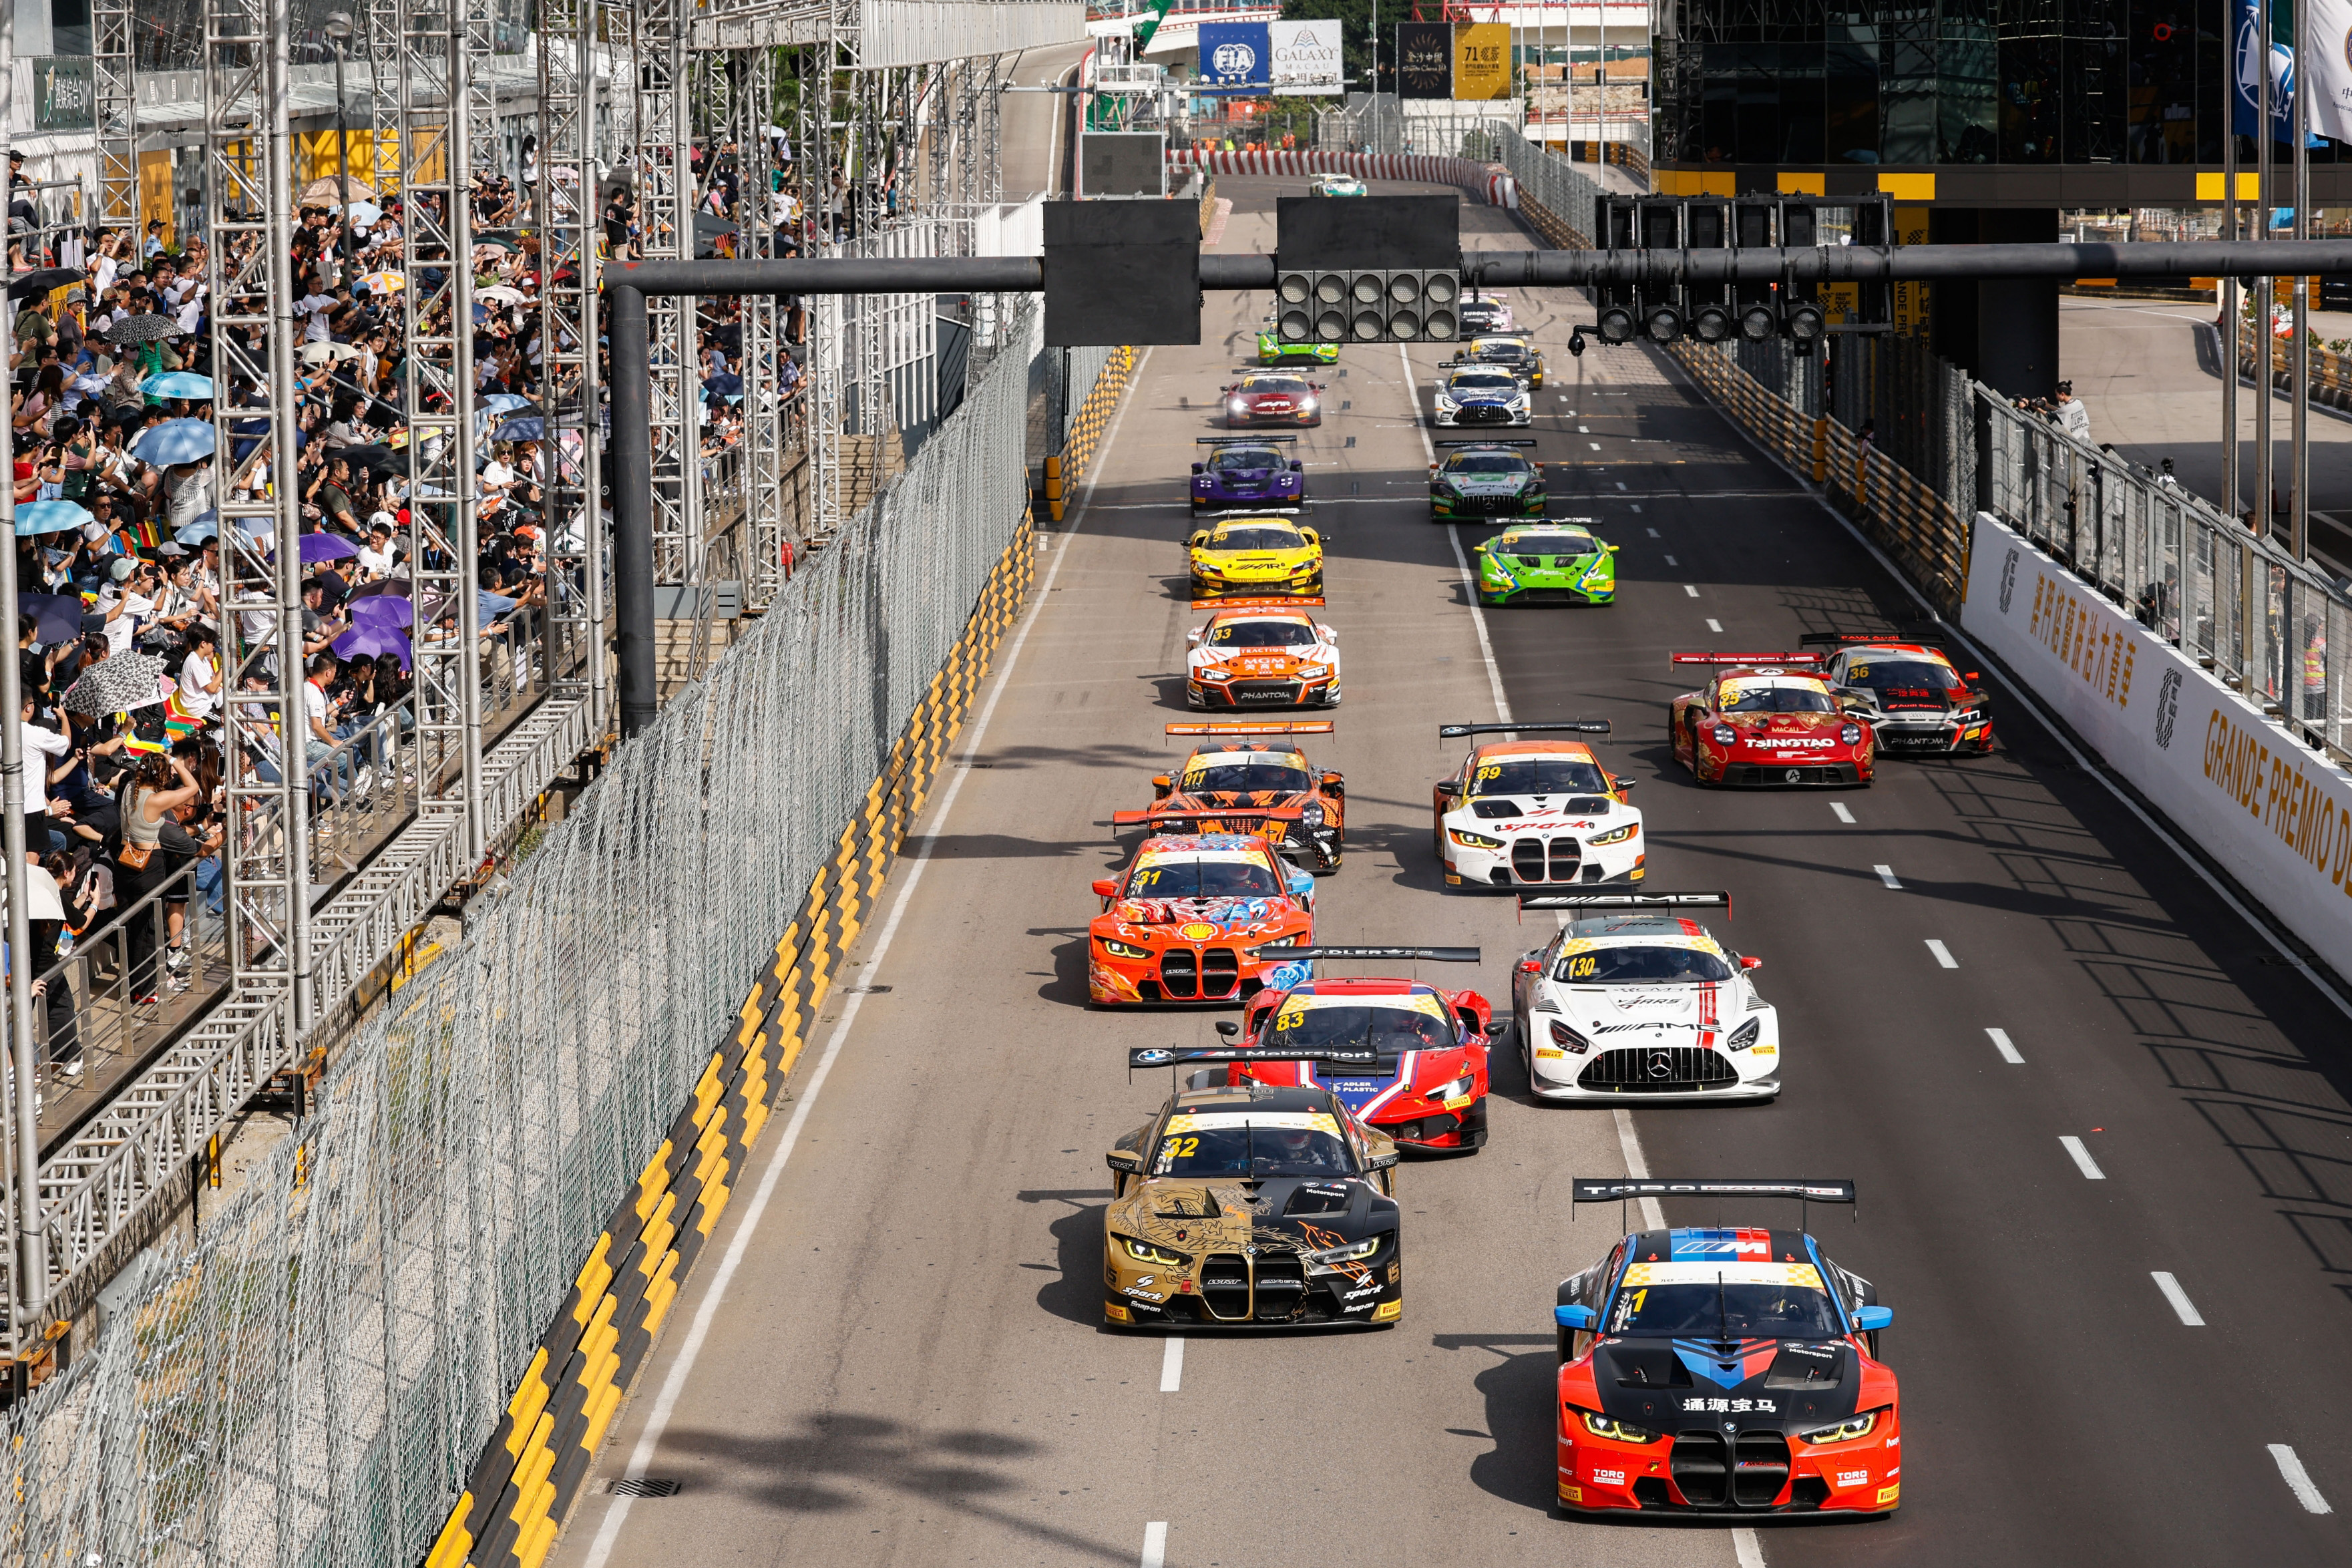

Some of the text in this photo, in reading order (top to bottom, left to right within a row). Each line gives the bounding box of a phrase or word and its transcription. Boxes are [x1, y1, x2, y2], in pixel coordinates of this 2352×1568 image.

[1276, 48, 1336, 61] GALAXY
[1464, 47, 1478, 61] 71
[79, 81, 92, 114] SJM
[1212, 532, 1228, 542] 50
[1502, 536, 1519, 544] 63
[1213, 628, 1231, 641] 33
[1849, 666, 1869, 679] 36
[1720, 693, 1740, 707] 25
[1744, 738, 1836, 748] TSINGTAO
[1184, 771, 1206, 787] 911
[1477, 766, 1501, 779] 89
[2204, 709, 2269, 819] GRANDE
[2265, 761, 2334, 873] PRÉMIO
[1500, 820, 1590, 832] spark
[1136, 871, 1161, 886] 31
[1569, 957, 1595, 976] 130
[1276, 1012, 1304, 1032] 83
[1245, 1050, 1373, 1058] Motorsport
[1752, 1046, 1775, 1054] PIRELLI
[1445, 1097, 1470, 1109] PIRELLI
[1165, 1137, 1199, 1157] 32
[1109, 1160, 1133, 1169] WRT
[1373, 1157, 1398, 1168] WRT
[1306, 1188, 1345, 1198] Motorsport
[1122, 1286, 1164, 1301] spark
[1343, 1284, 1384, 1300] spark
[1130, 1300, 1161, 1313] Snap-on
[1631, 1288, 1648, 1312] 1
[1343, 1302, 1374, 1313] Snap-on
[1789, 1348, 1833, 1359] Motorsport
[1683, 1398, 1776, 1413] 通源宝马
[1593, 1468, 1625, 1479] TORO
[1836, 1470, 1868, 1481] TORO
